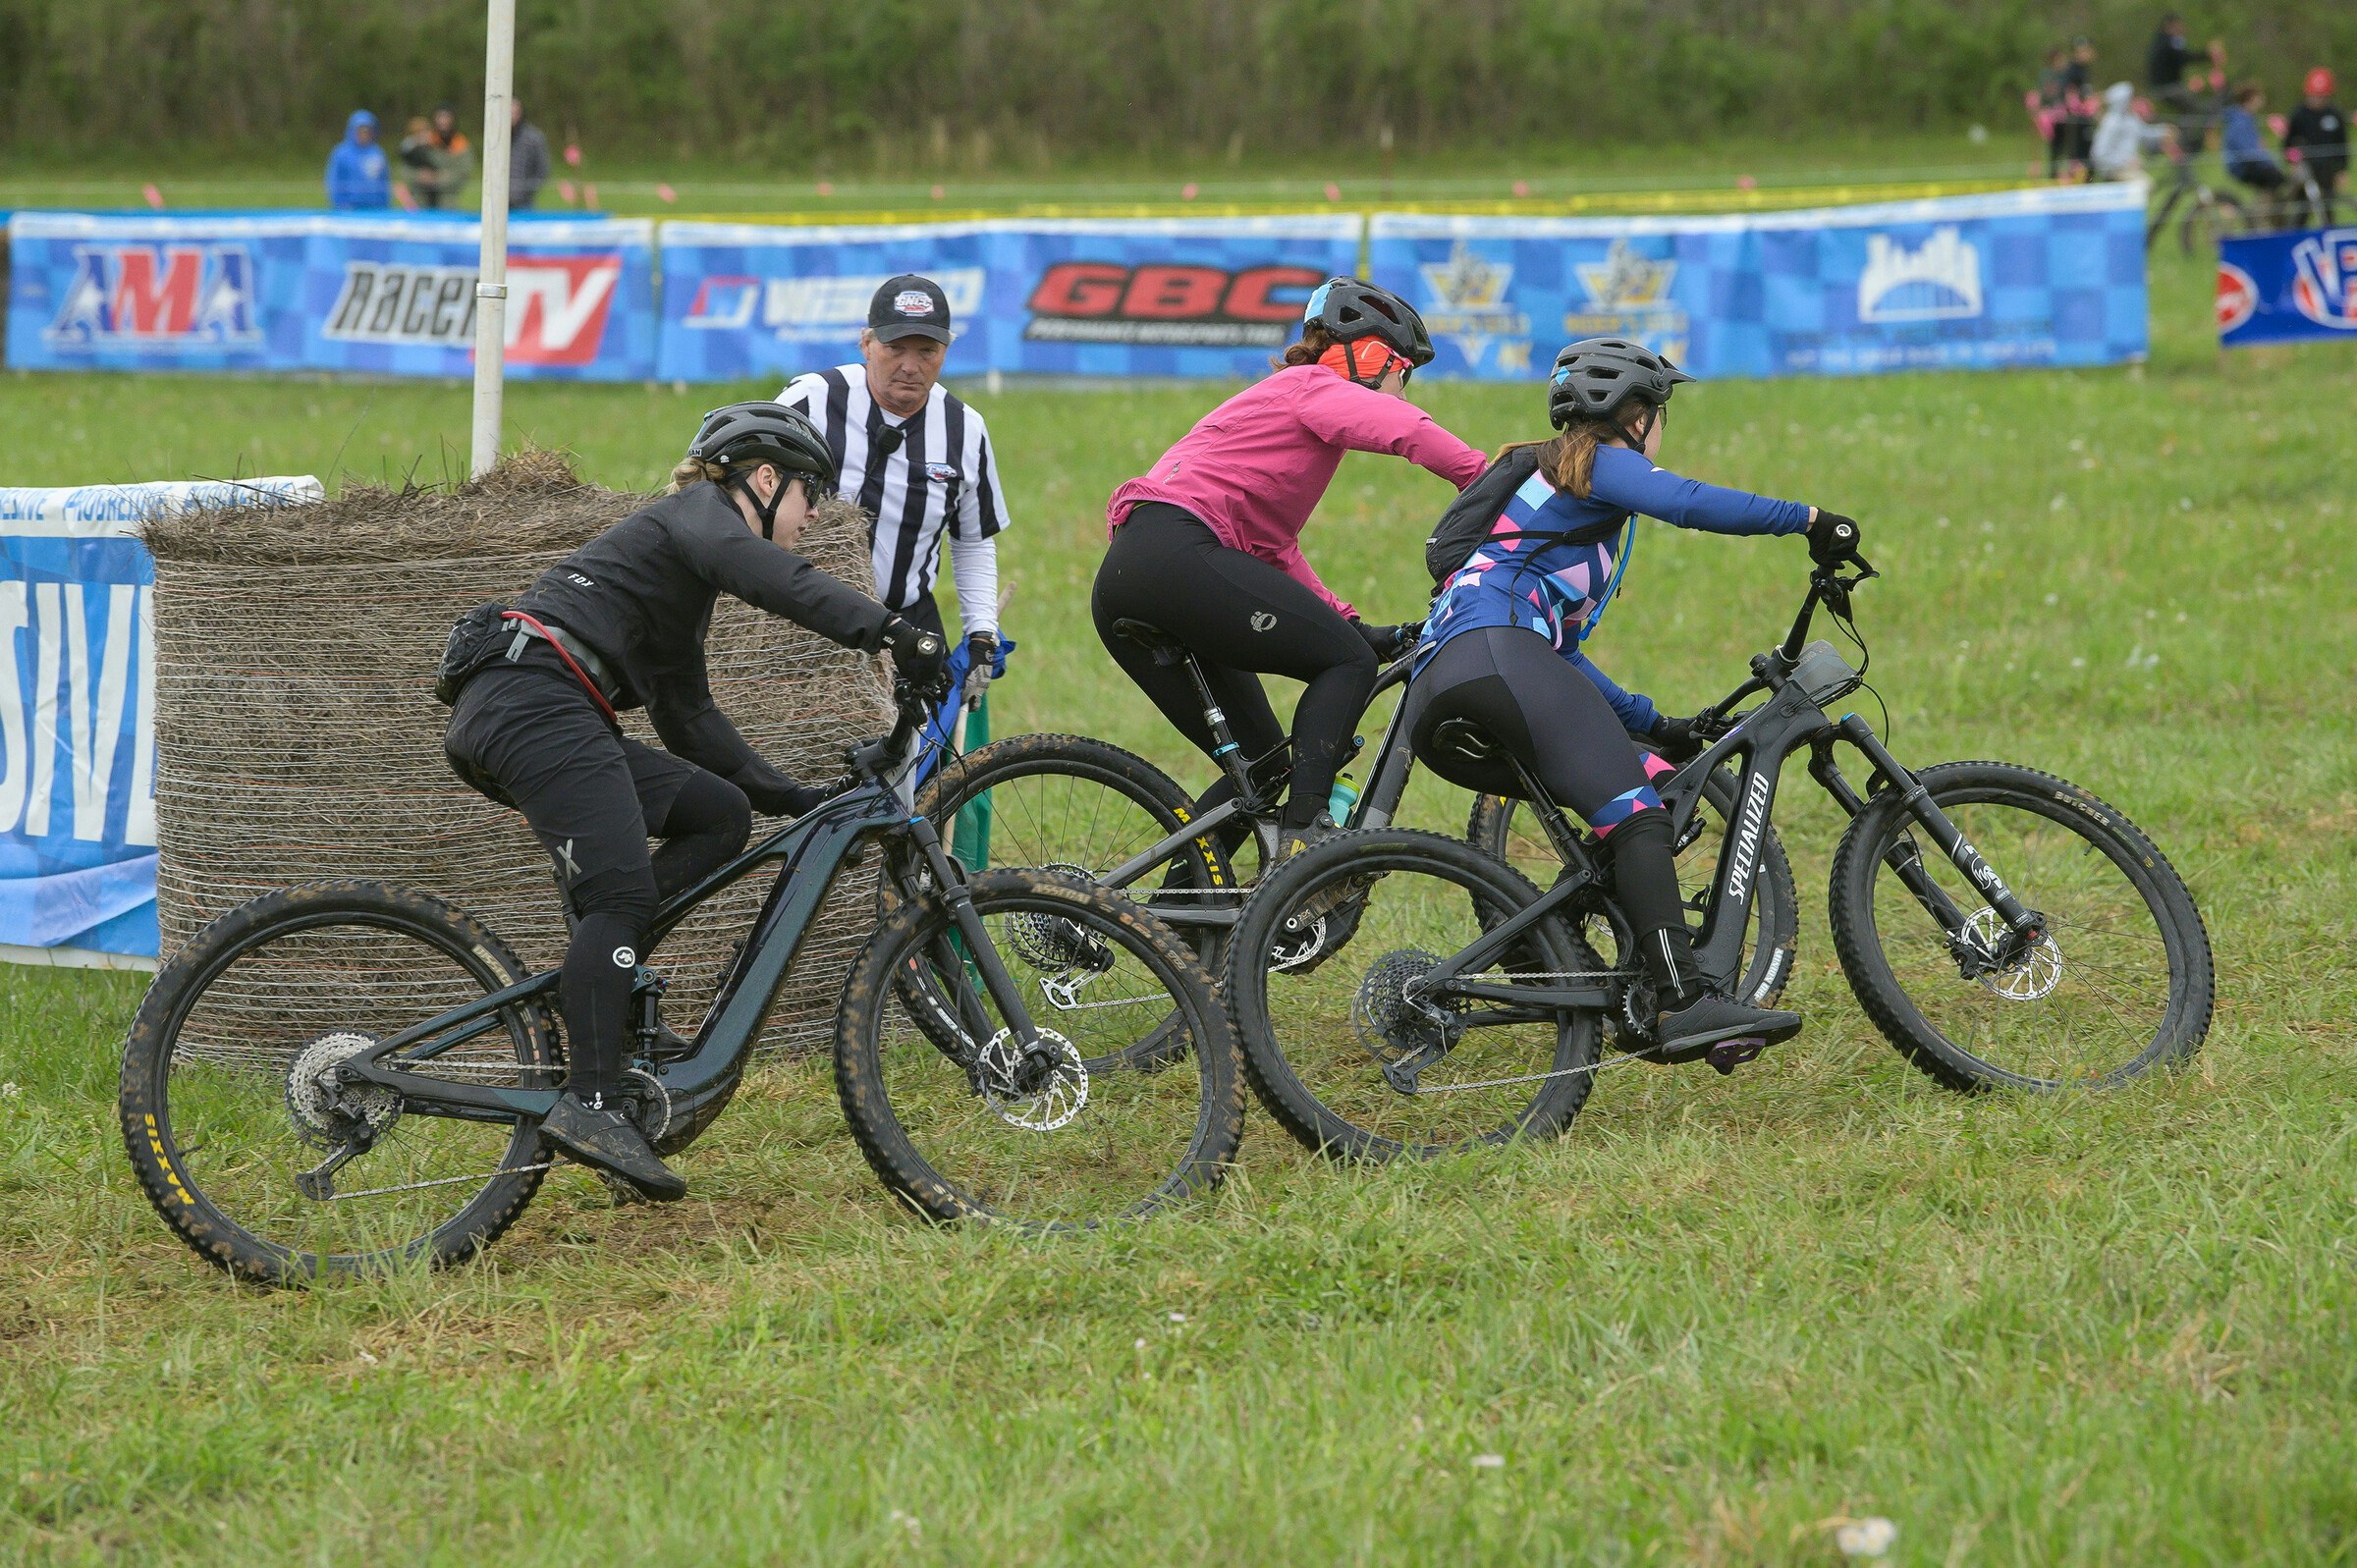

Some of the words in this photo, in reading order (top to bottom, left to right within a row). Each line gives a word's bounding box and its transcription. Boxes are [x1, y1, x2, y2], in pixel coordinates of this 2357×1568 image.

[41, 244, 265, 342] AMA
[1027, 261, 1324, 322] GBC
[567, 572, 594, 587] FOX
[1173, 806, 1224, 886] MXXIS
[1727, 771, 1770, 905] SPECIALIZED
[2055, 789, 2110, 827] BUTCHER
[144, 1111, 195, 1206] MAXXIS
